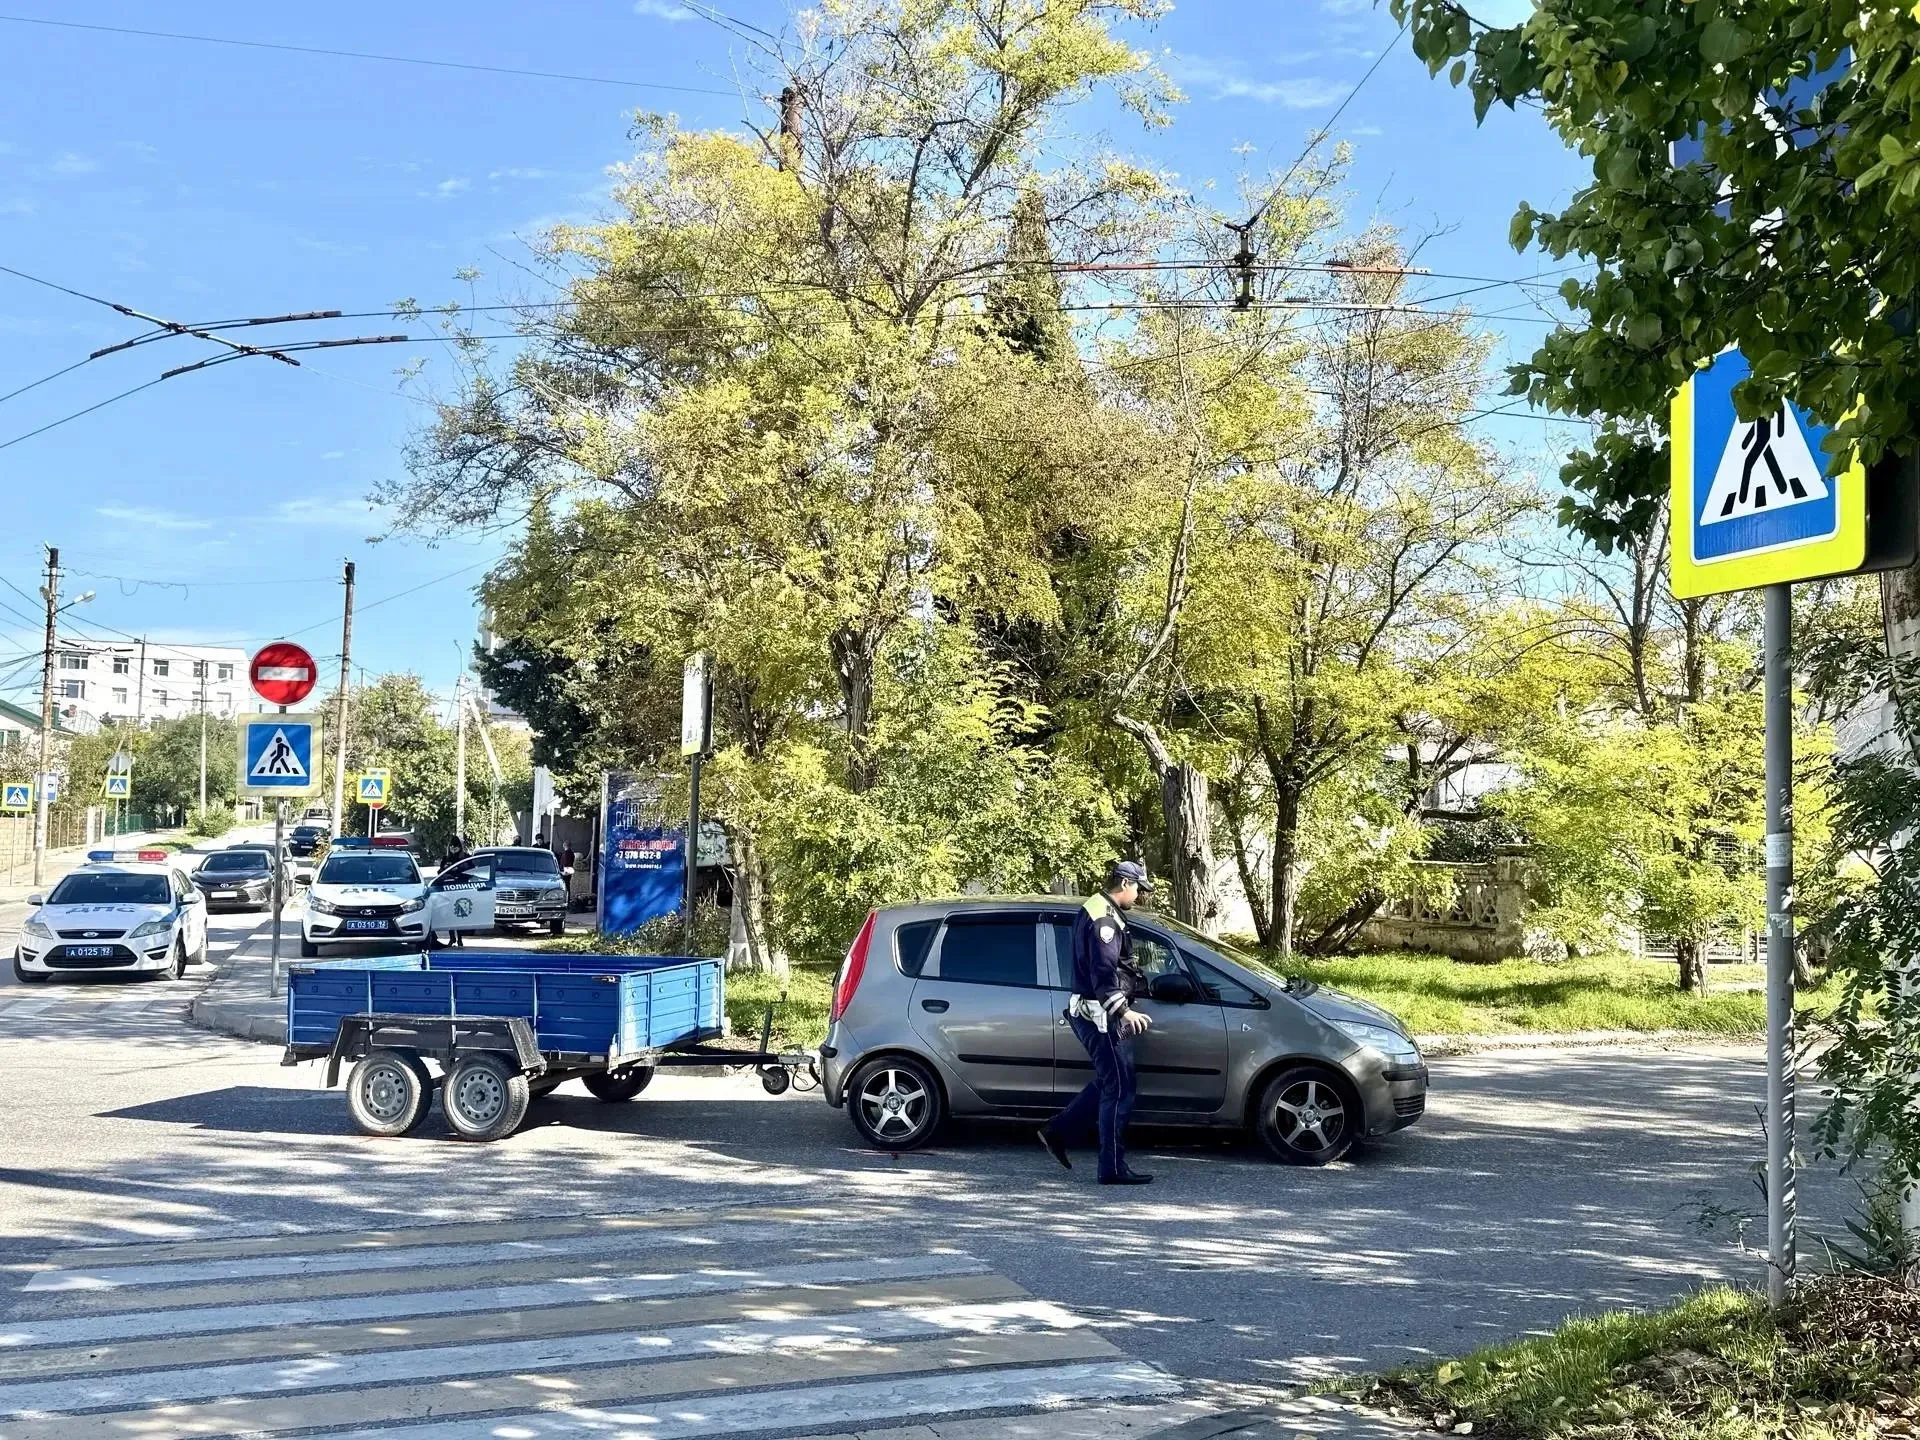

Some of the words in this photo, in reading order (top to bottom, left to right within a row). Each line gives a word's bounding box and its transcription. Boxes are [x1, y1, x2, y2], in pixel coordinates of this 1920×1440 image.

[443, 882, 487, 891] ПОЛИЦИЯ
[65, 906, 135, 914] ДПС
[77, 948, 98, 956] 0125
